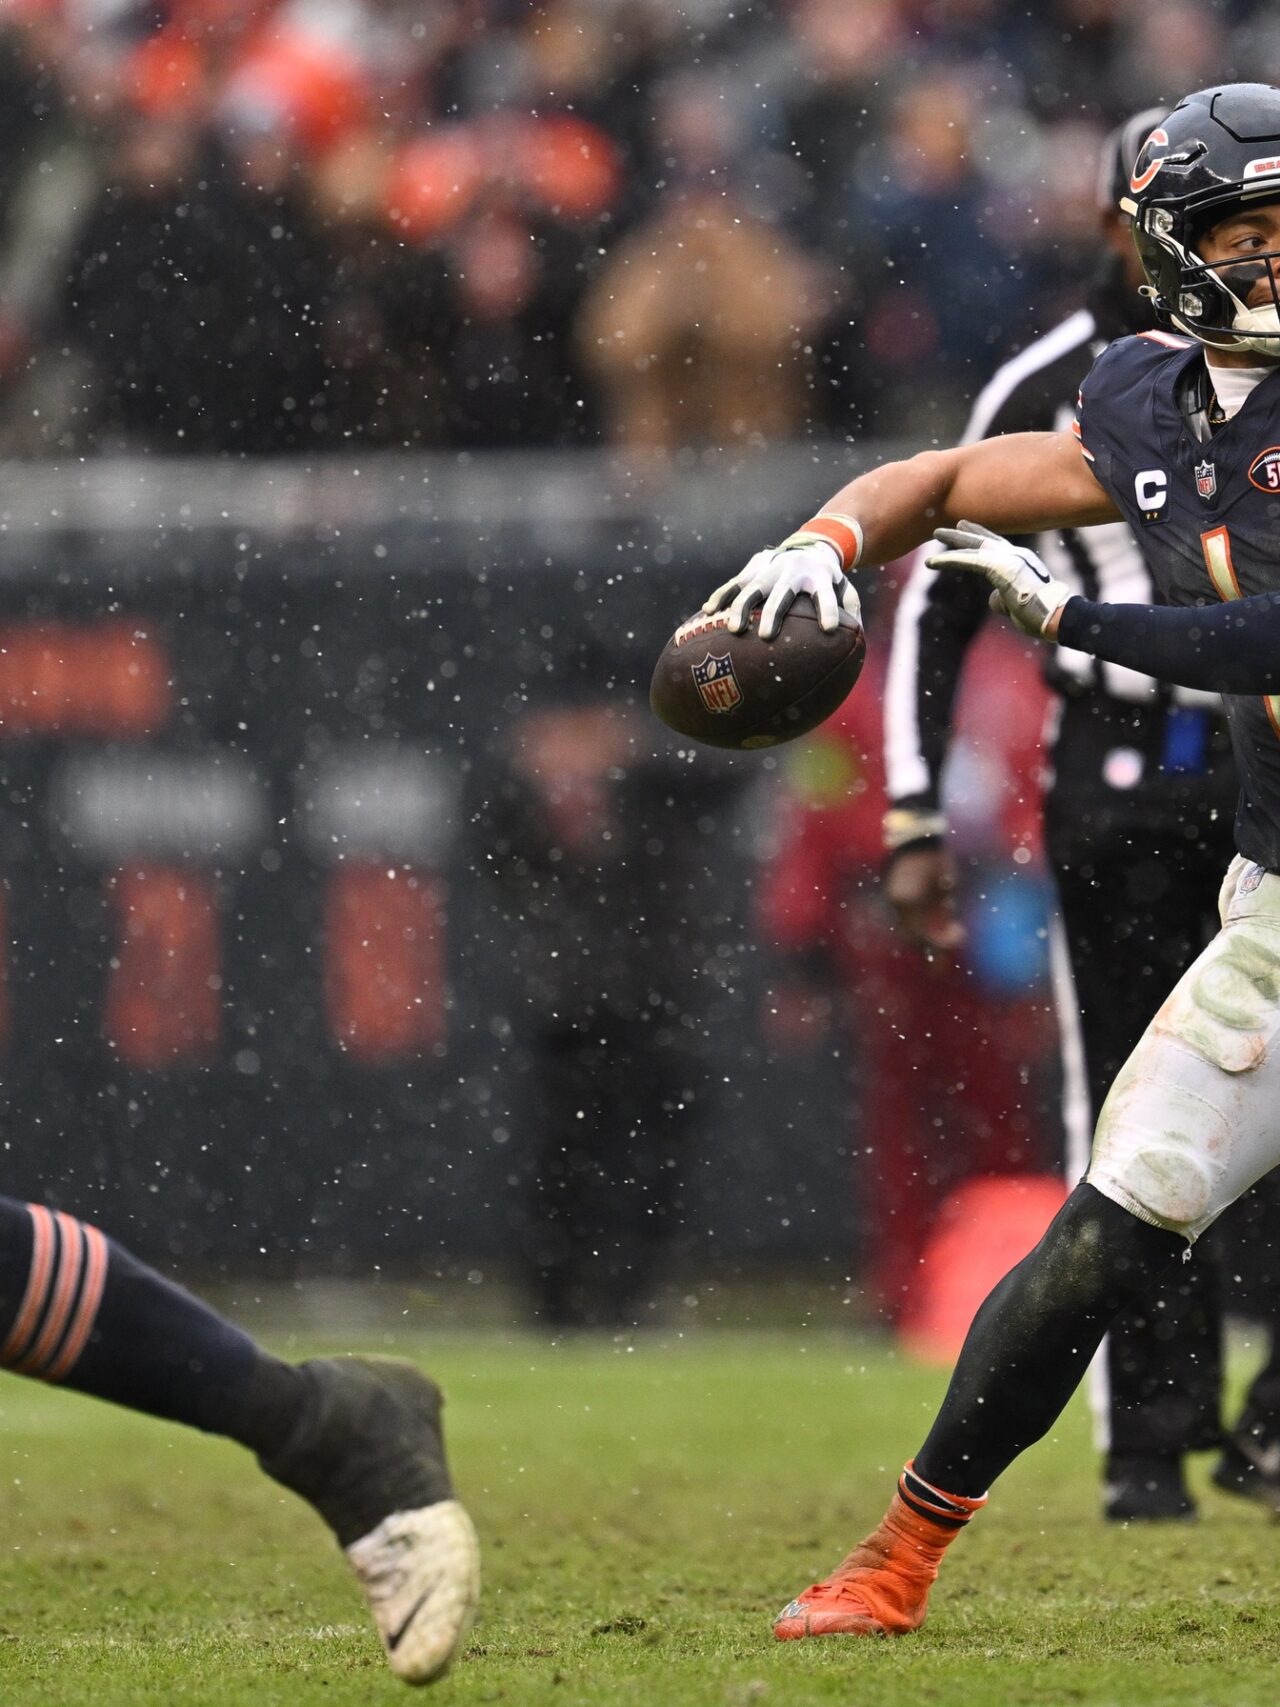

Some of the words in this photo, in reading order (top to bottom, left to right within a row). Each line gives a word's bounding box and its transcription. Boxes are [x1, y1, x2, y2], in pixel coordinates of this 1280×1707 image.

[1134, 469, 1168, 511] C
[1199, 478, 1214, 494] NFL
[701, 677, 740, 709] NFL
